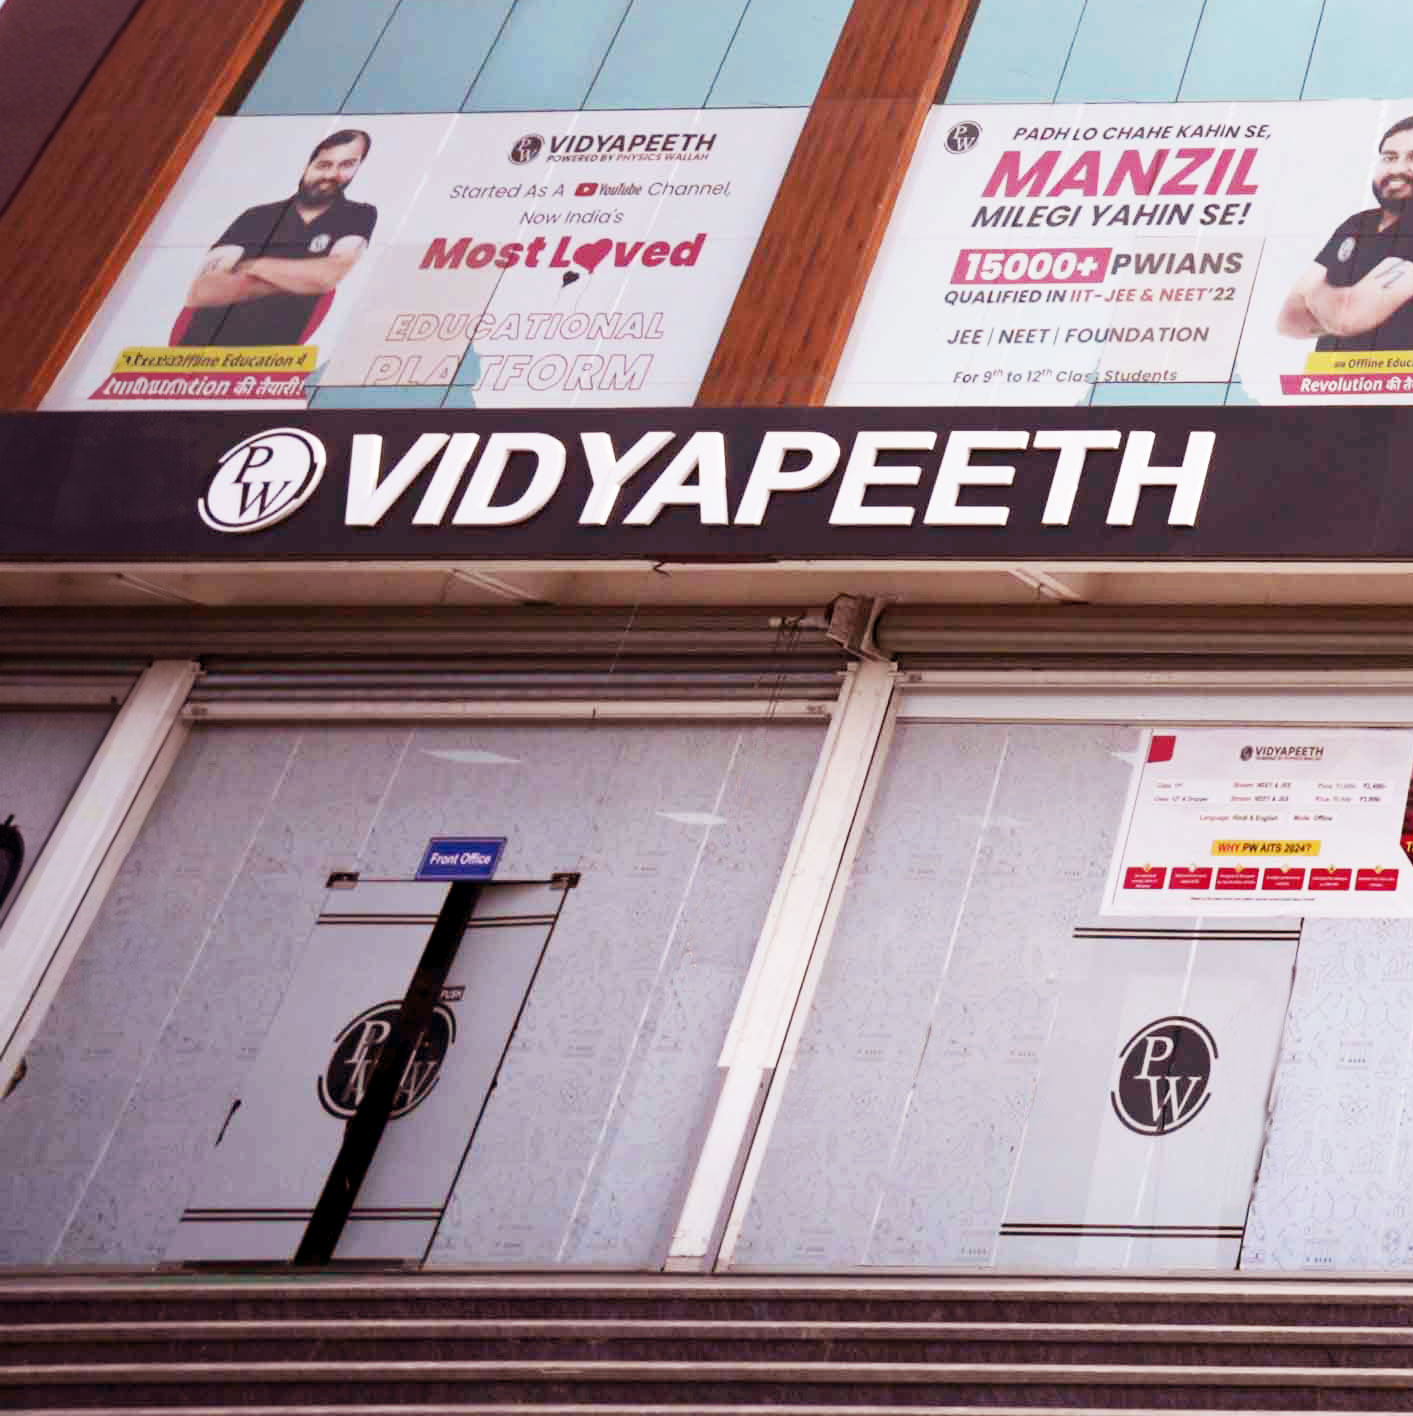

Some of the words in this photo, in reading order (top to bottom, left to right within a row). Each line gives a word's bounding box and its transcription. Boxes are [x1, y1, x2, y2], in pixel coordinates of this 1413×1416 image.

[1013, 127, 1070, 141] PADH
[1072, 127, 1097, 141] LO
[1103, 126, 1173, 140] CHAHE
[1176, 125, 1241, 139] KAHIN
[1244, 124, 1272, 140] SE,
[550, 134, 716, 152] VIDYAPEETH
[981, 148, 1258, 197] MANZIL
[450, 183, 519, 199] Started
[524, 184, 547, 199] As
[551, 184, 565, 198] A
[647, 182, 731, 197] Channel,
[520, 211, 559, 224] Now
[565, 209, 624, 224] India's
[971, 205, 1082, 228] MILEGI
[1091, 203, 1194, 226] YAHIN
[1199, 203, 1251, 225] SE!
[419, 237, 545, 270] Most
[965, 252, 1098, 281] 15000+
[1111, 253, 1243, 275] PWIANS
[944, 290, 1042, 305] QUALIFIED
[1047, 290, 1066, 303] IN
[1070, 289, 1136, 303] IIT-JEE
[1159, 287, 1236, 302] NEET'22
[385, 312, 664, 341] EDUCATIONAL
[947, 330, 983, 345] JEE
[998, 329, 1051, 345] NEET
[1064, 327, 1209, 343] FOUNDATION
[363, 354, 654, 391] PLATFORM
[953, 371, 979, 384] For
[1006, 371, 1023, 383] to
[1104, 369, 1177, 383] Students
[1300, 377, 1383, 393] Revolution
[344, 430, 1216, 527] VIDYAPEETH
[1255, 746, 1324, 757] VIDYAPEETH
[429, 852, 459, 865] Front
[460, 852, 492, 865] Office
